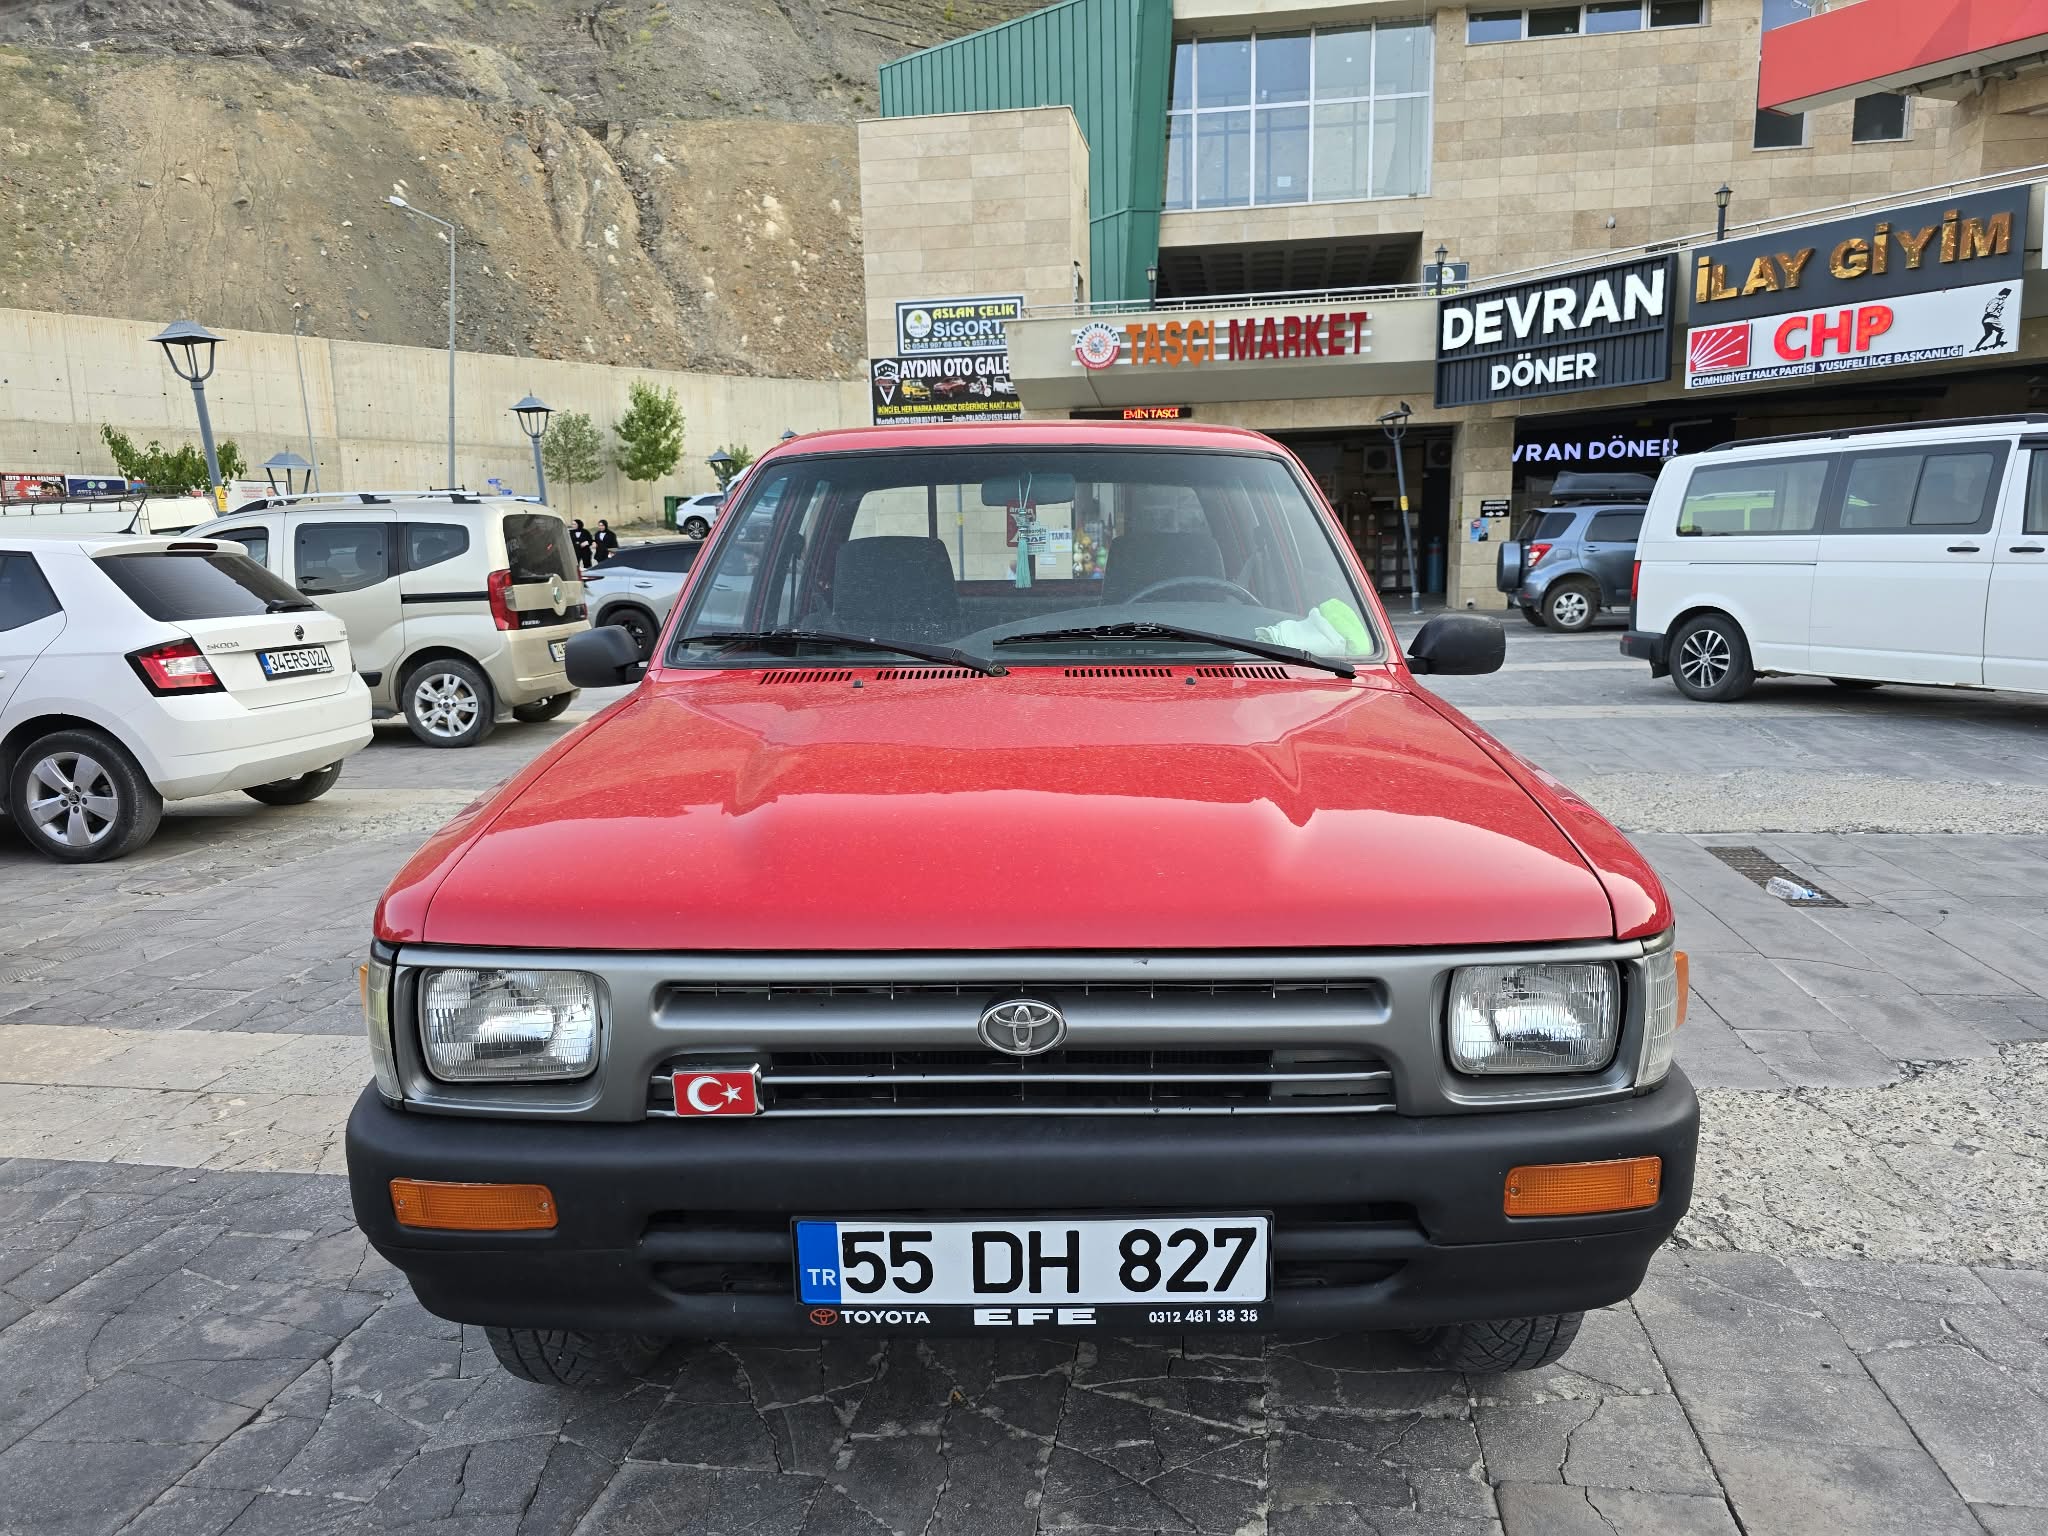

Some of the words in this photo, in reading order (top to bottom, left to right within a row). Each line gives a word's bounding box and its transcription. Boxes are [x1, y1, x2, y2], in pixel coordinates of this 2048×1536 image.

[1696, 247, 1816, 303] İLAY
[1828, 208, 2014, 280] GİYİM
[932, 306, 975, 320] ASLAN
[979, 303, 1015, 319] ÇELİK
[1442, 268, 1665, 350] DEVRAN
[1228, 312, 1367, 361] MARKET
[1773, 305, 1894, 361] CHP
[900, 358, 942, 379] AYDIN
[943, 356, 973, 377] OTO
[1491, 352, 1599, 391] DÖNER
[1692, 371, 1752, 387] CUMHURİYET
[1752, 368, 1779, 380] HALK
[1779, 362, 1816, 376] PARTİSİ
[1819, 356, 1869, 372] YUSUFELİ
[1869, 353, 1893, 368] İLÇE
[1893, 345, 1964, 364] BAŞKANLIĞI
[1588, 434, 1679, 460] DÖNER
[807, 1268, 836, 1286] TR
[841, 1231, 934, 1294] 55
[971, 1230, 1080, 1294] DH
[1118, 1228, 1257, 1293] 827
[841, 1310, 930, 1324] TOYOTA
[973, 1308, 1097, 1326] EFE
[1148, 1311, 1181, 1324] 0312
[1185, 1309, 1212, 1323] 481
[1217, 1309, 1236, 1323] 38
[1239, 1309, 1258, 1323] 38
